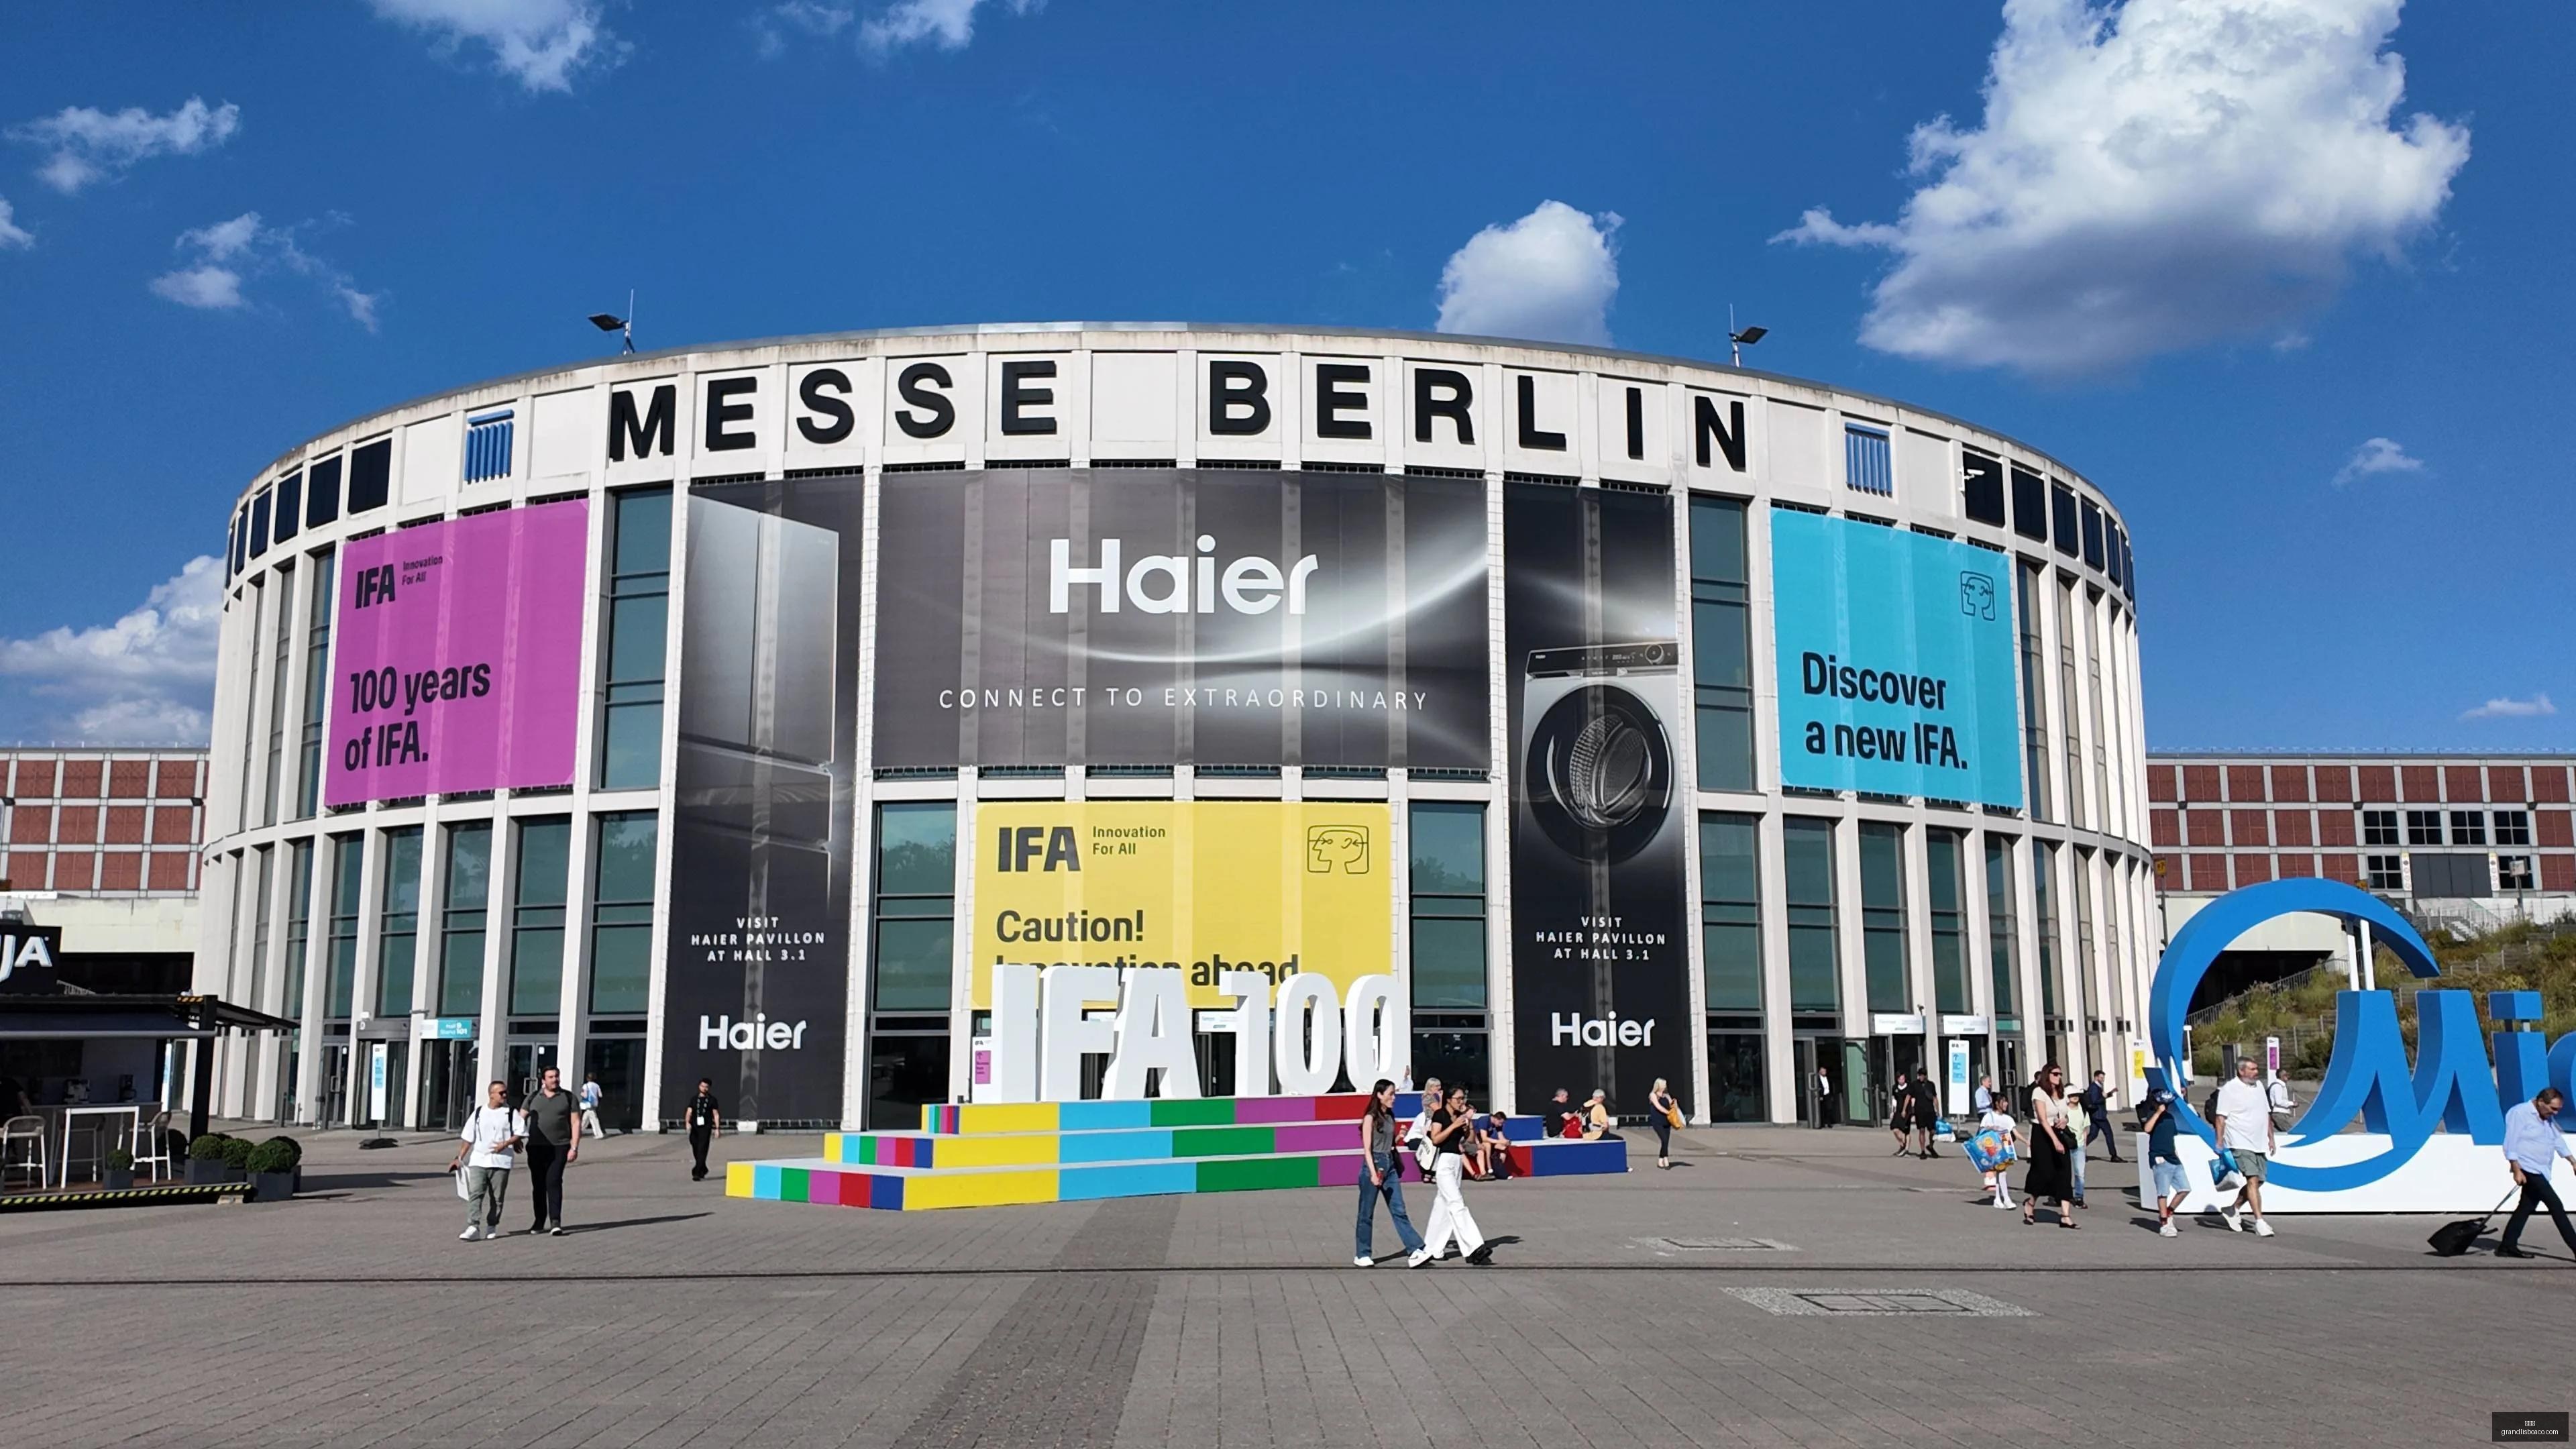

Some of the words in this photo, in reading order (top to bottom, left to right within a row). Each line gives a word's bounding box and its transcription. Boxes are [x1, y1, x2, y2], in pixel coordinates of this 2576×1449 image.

[608, 360, 1057, 462] MESSE
[1209, 360, 1746, 472] BERLIN
[402, 574, 415, 585] For
[415, 572, 427, 584] All
[403, 555, 443, 571] Innovation
[1049, 535, 1318, 614] Haier
[355, 564, 396, 609] IFA
[350, 666, 397, 714] 100
[404, 663, 491, 716] years
[1803, 651, 1946, 710] Discover
[939, 688, 1085, 710] CONNECT
[1106, 688, 1142, 708] TO
[1165, 688, 1427, 711] EXTRAORDINARY
[345, 727, 372, 771] of
[376, 720, 429, 767] IFA.
[1805, 721, 1825, 755] a
[1835, 723, 1907, 762] new
[1914, 722, 1968, 769] IFA.
[1093, 826, 1166, 838] Innovation
[998, 826, 1081, 872] IFA
[1093, 843, 1114, 855] For
[1118, 843, 1136, 855] All
[691, 934, 737, 945] HAIER
[746, 932, 824, 945] PAVILLON
[737, 916, 779, 928] VISIT
[996, 910, 1143, 943] Caution!
[1536, 932, 1583, 943] HAIER
[1593, 933, 1665, 945] PAVILLON
[1581, 916, 1622, 928] VISIT
[707, 950, 725, 961] AT
[734, 949, 771, 961] HALL
[781, 949, 805, 961] 3.1
[1554, 948, 1572, 959] AT
[1580, 949, 1618, 959] HALL
[1626, 949, 1649, 960] 3.1
[699, 1012, 807, 1050] Haier
[992, 965, 1201, 1104] IFA
[1219, 971, 1411, 1098] 100
[1552, 1011, 1656, 1046] Haier
